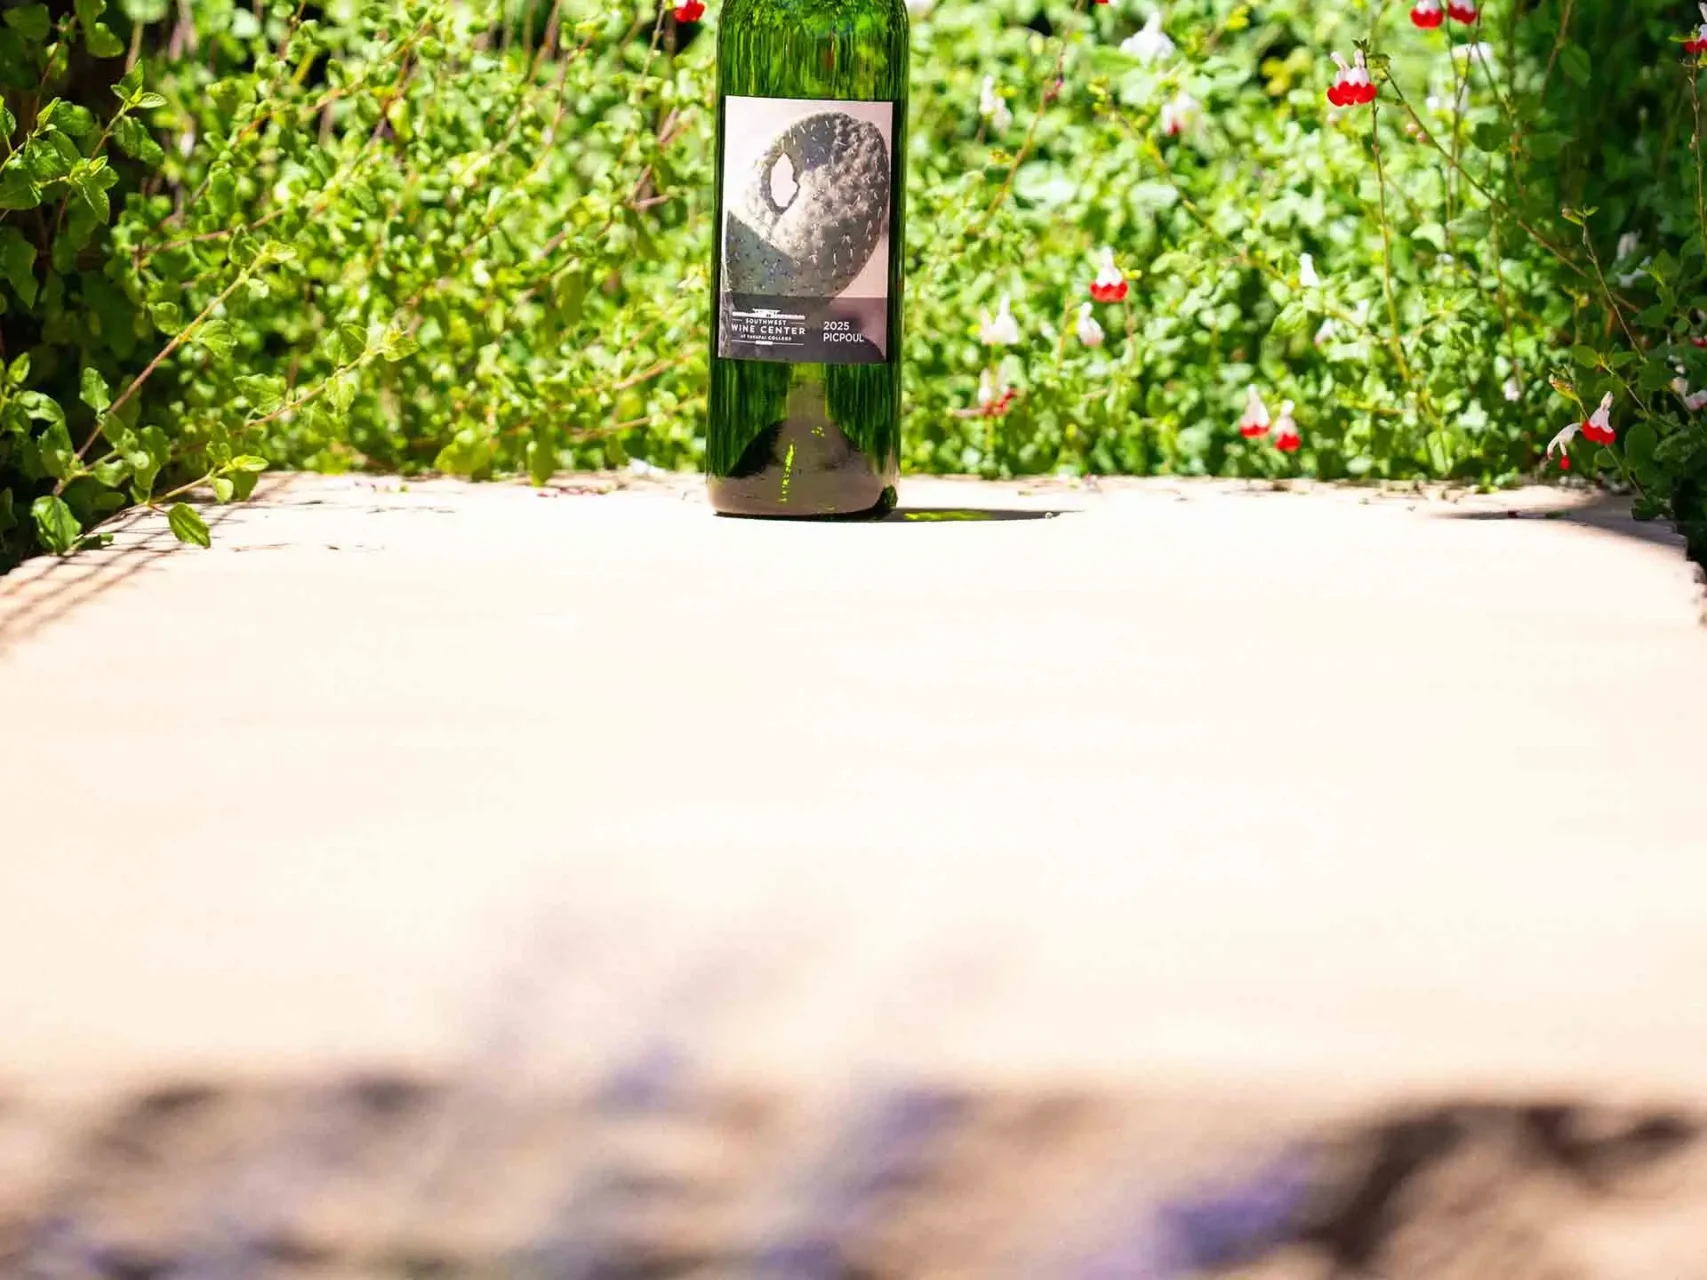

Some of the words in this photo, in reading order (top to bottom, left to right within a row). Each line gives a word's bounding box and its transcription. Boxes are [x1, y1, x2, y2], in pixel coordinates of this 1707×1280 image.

[745, 318, 787, 326] SOUTHWEST
[823, 321, 850, 331] 2025
[731, 323, 755, 333] WINE
[760, 326, 806, 335] CENTER
[823, 332, 864, 343] PICPOUL
